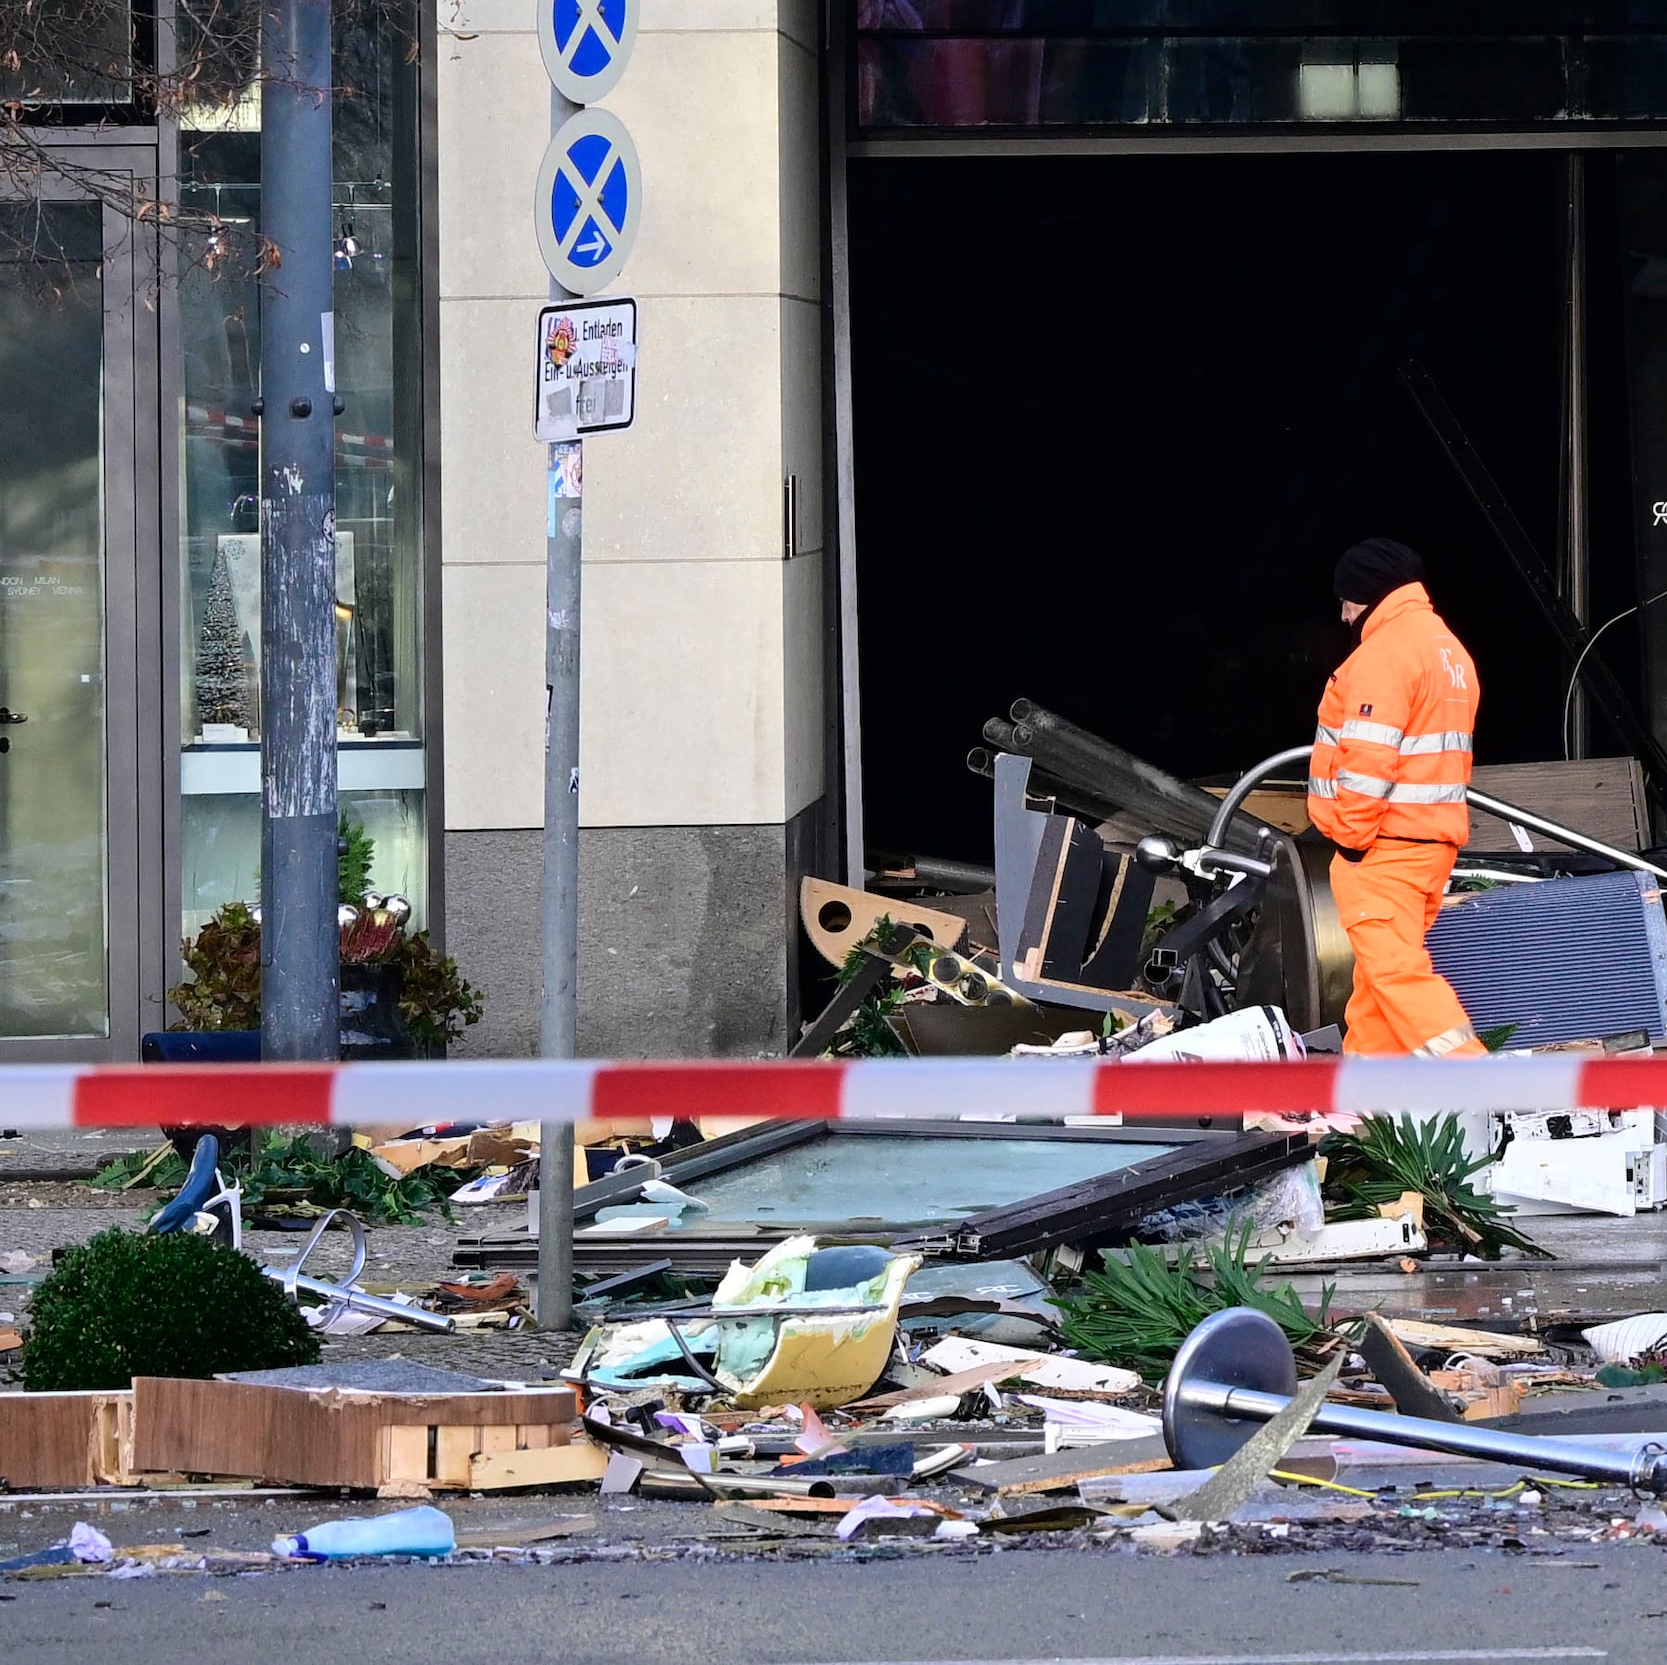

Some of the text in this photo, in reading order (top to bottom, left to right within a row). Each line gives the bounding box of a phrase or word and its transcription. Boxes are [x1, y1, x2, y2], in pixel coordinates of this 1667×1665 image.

[582, 317, 623, 341] Entladen
[34, 576, 61, 585] MILAN
[7, 586, 41, 596] SYDNEY
